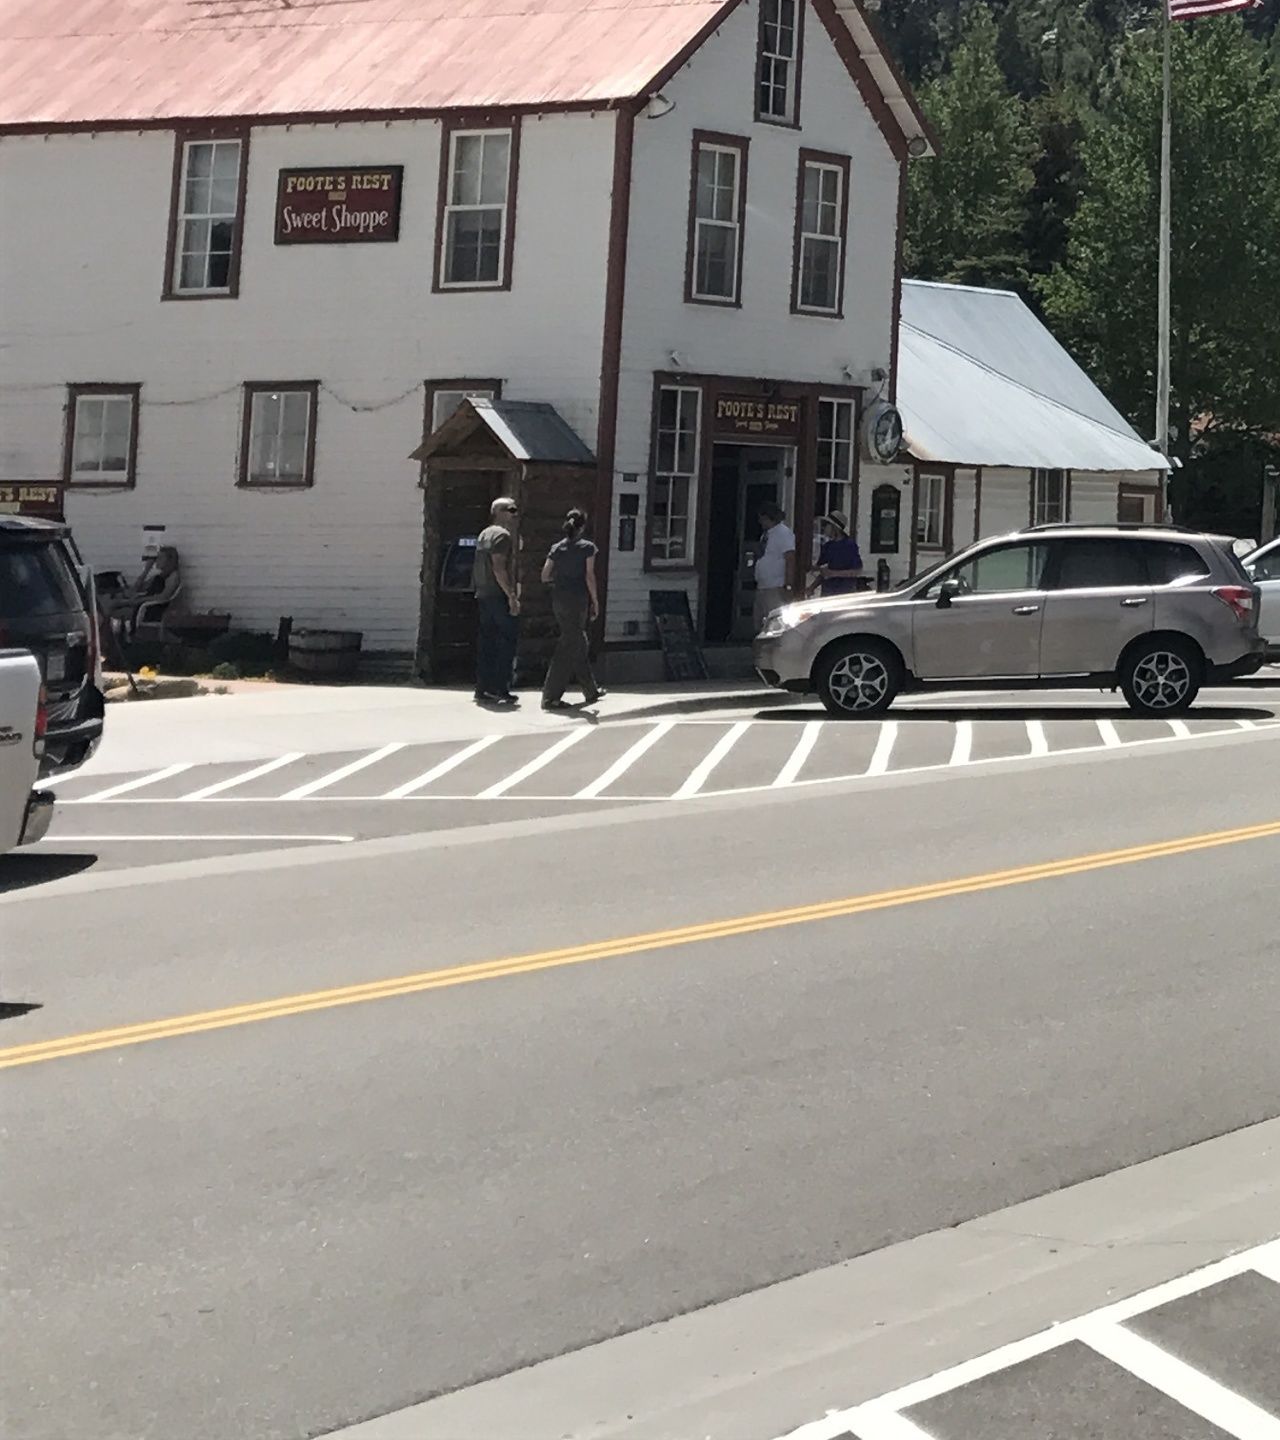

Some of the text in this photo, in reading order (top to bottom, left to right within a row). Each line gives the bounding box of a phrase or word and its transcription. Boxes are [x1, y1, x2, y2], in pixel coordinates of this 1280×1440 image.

[286, 174, 392, 193] FOOTE'S REST
[282, 204, 389, 234] Sweet Shoppe
[717, 400, 797, 422] FOOTE'S REST
[18, 487, 57, 502] REST
